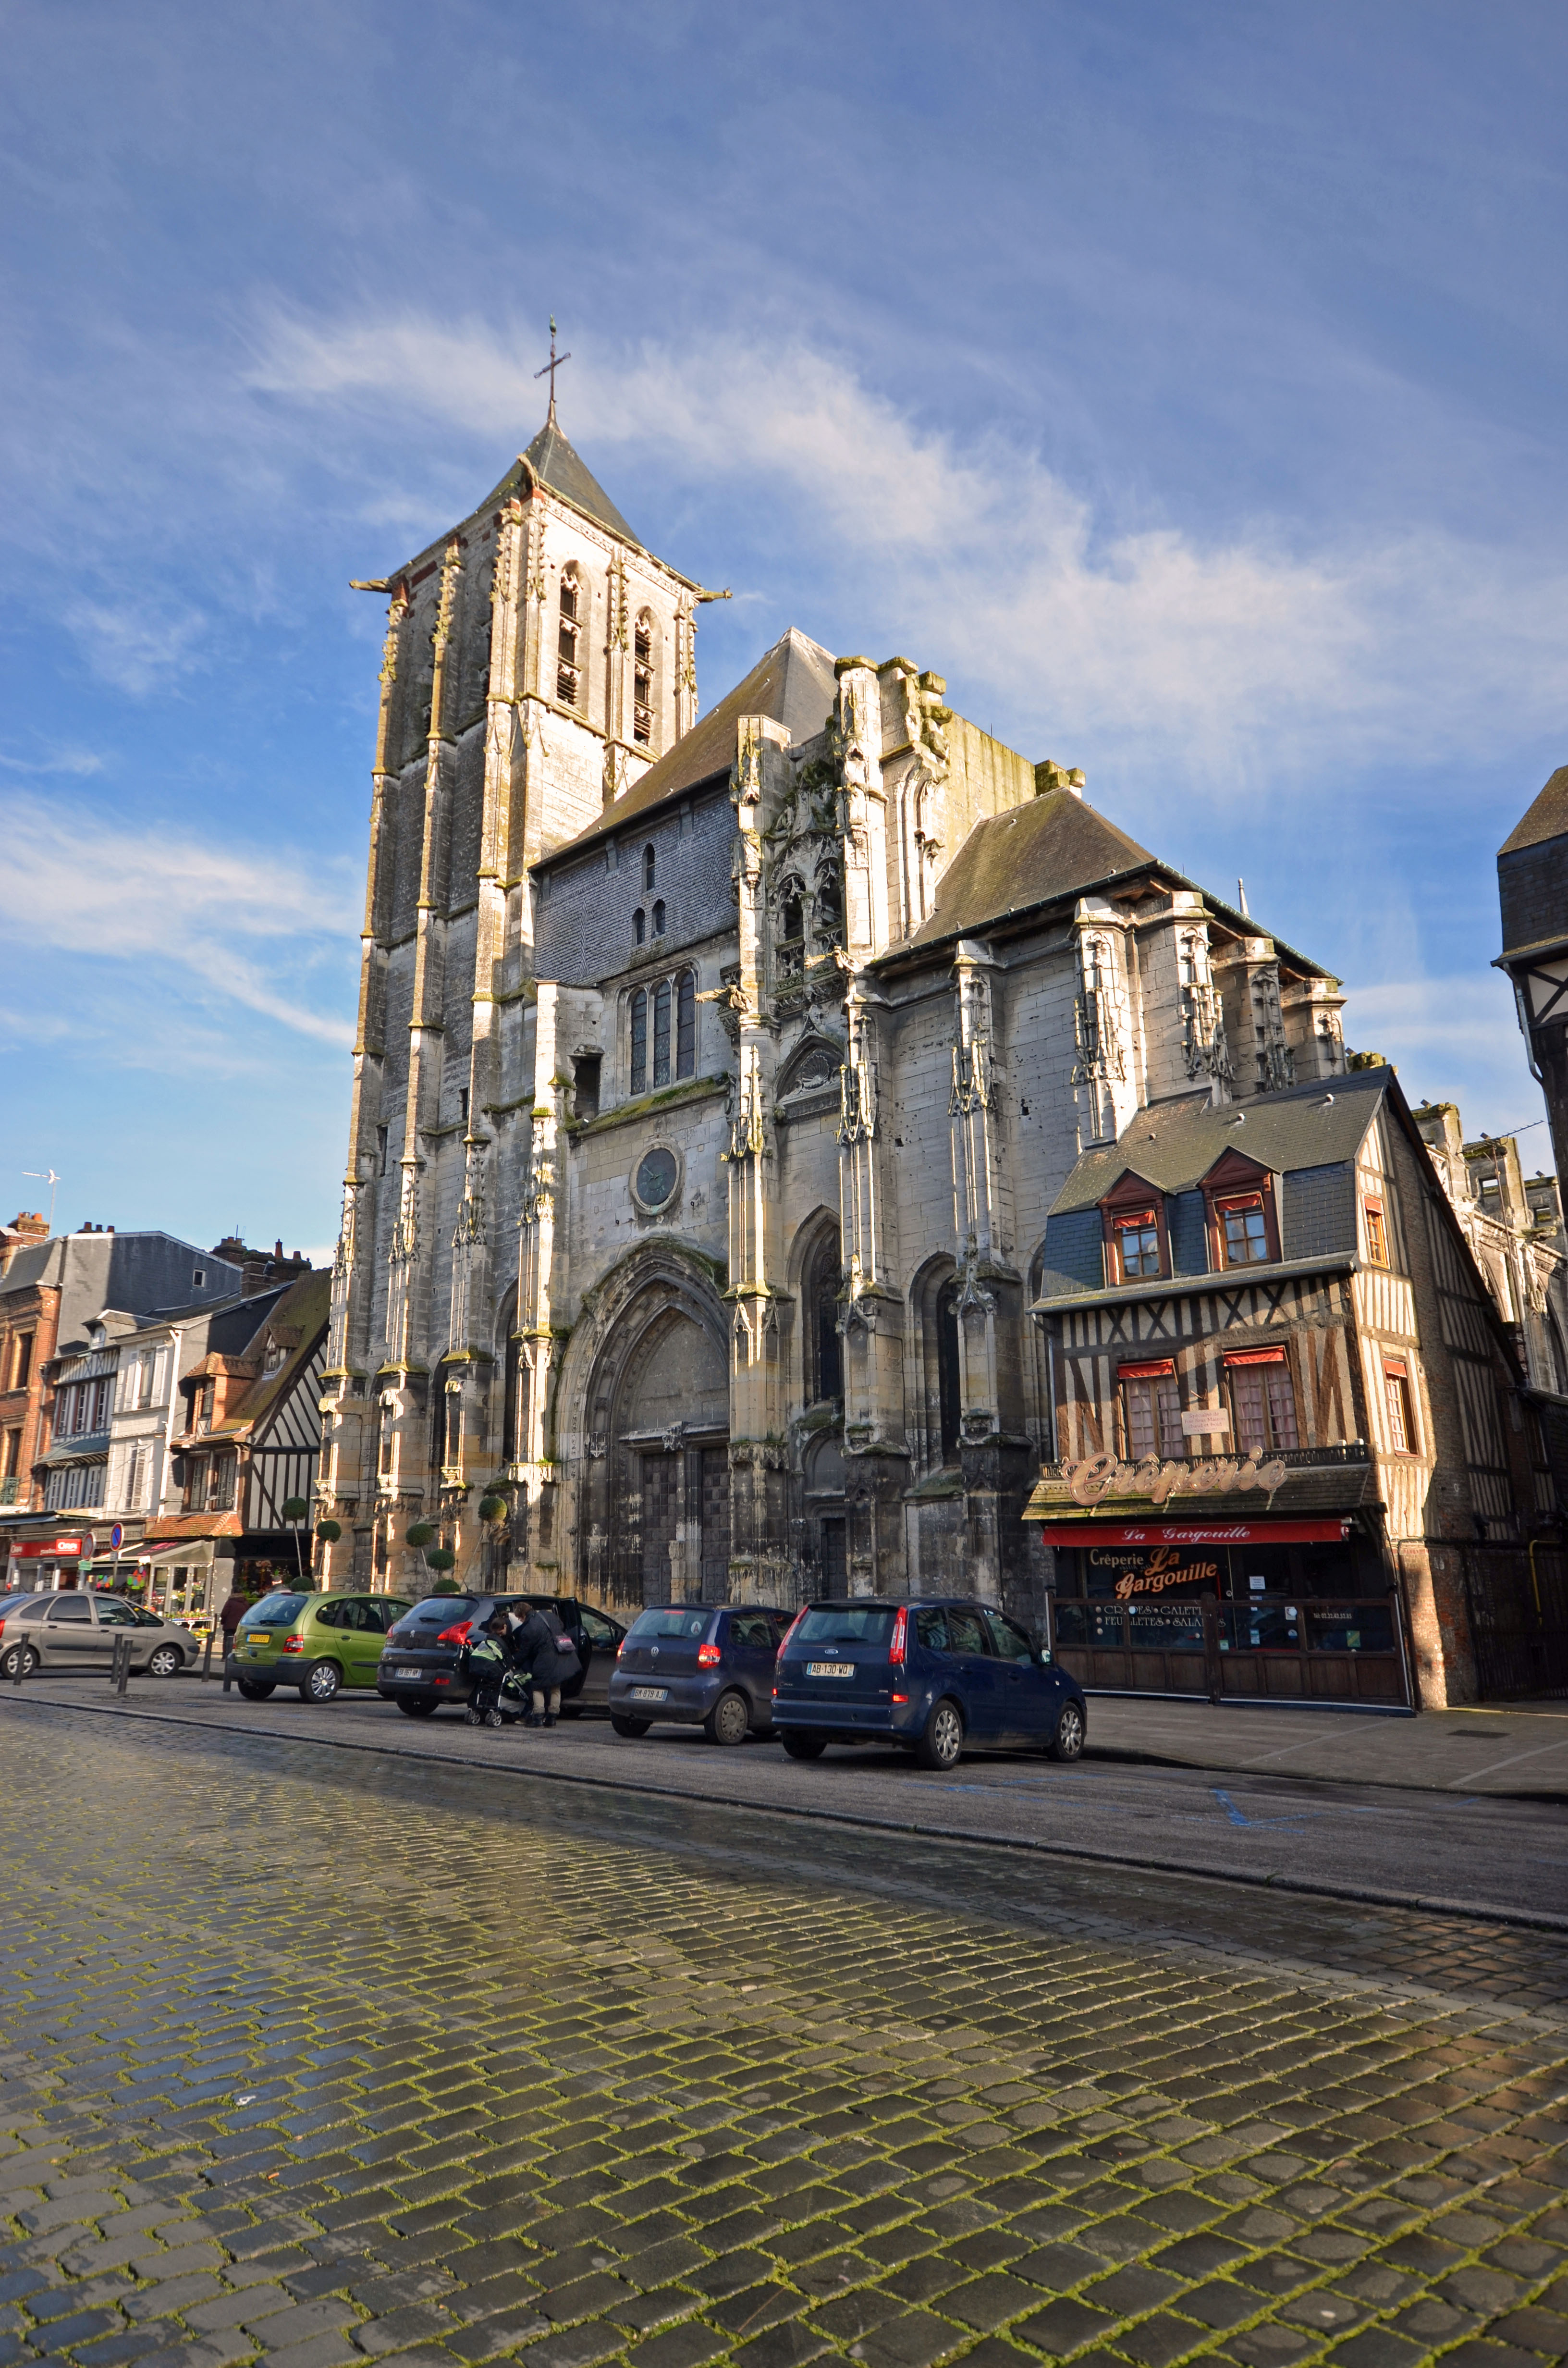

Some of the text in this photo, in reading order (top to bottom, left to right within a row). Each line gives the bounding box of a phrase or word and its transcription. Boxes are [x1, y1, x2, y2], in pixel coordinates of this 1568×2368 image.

[1061, 1445, 1287, 1506] Crêperie
[1122, 1526, 1250, 1542] La Gargouille
[1090, 1548, 1144, 1567] Crêperie
[1144, 1545, 1180, 1576] La
[1115, 1562, 1218, 1599] Gargouille
[1104, 1605, 1152, 1615] CRES
[1173, 1618, 1226, 1628] SALAS
